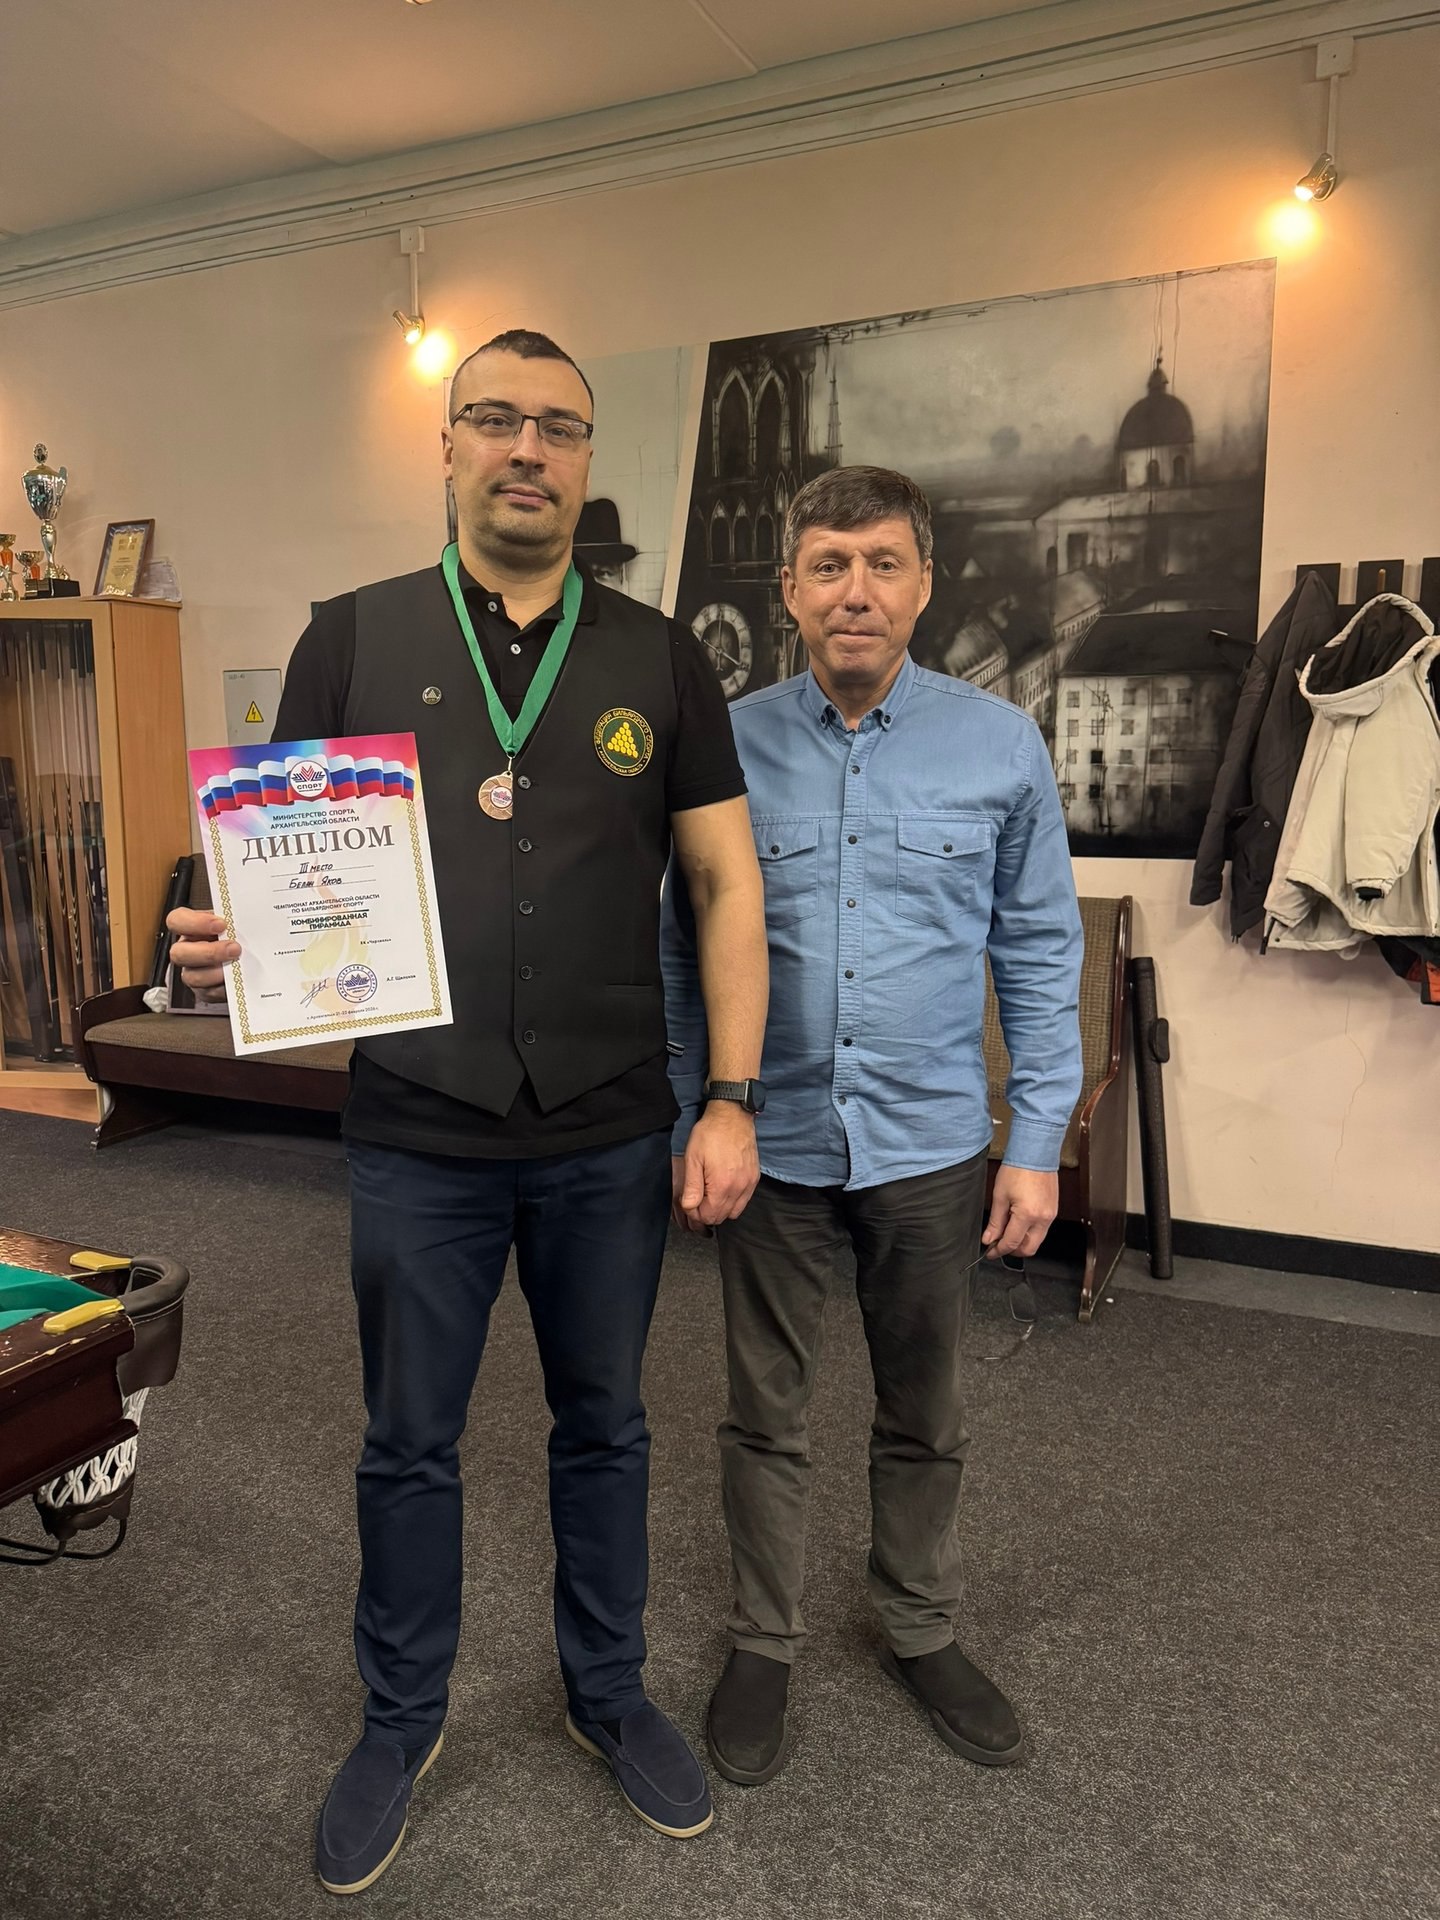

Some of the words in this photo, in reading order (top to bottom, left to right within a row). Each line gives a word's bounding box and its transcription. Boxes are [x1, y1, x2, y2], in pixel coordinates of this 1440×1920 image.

[272, 810, 327, 821] МИНИСТЕРСТВО
[328, 808, 355, 816] СПОРТА
[270, 818, 328, 830] АРХАНГЕЛЬСКОЙ
[328, 816, 360, 824] ОБЛАСТИ
[242, 824, 395, 866] ДИПЛОМ
[273, 902, 309, 910] ЧЕМПИОНАТ
[308, 896, 355, 906] АРХАНГЕЛЬСКОЙ
[354, 893, 380, 902] ОБЛАСТИ
[301, 903, 342, 913] БИЛЬЯРДНОМУ
[342, 901, 364, 909] СПОРТУ
[291, 912, 368, 926] КОМБИНИРОВАННАЯ
[309, 920, 352, 930] ПИРАМИДА
